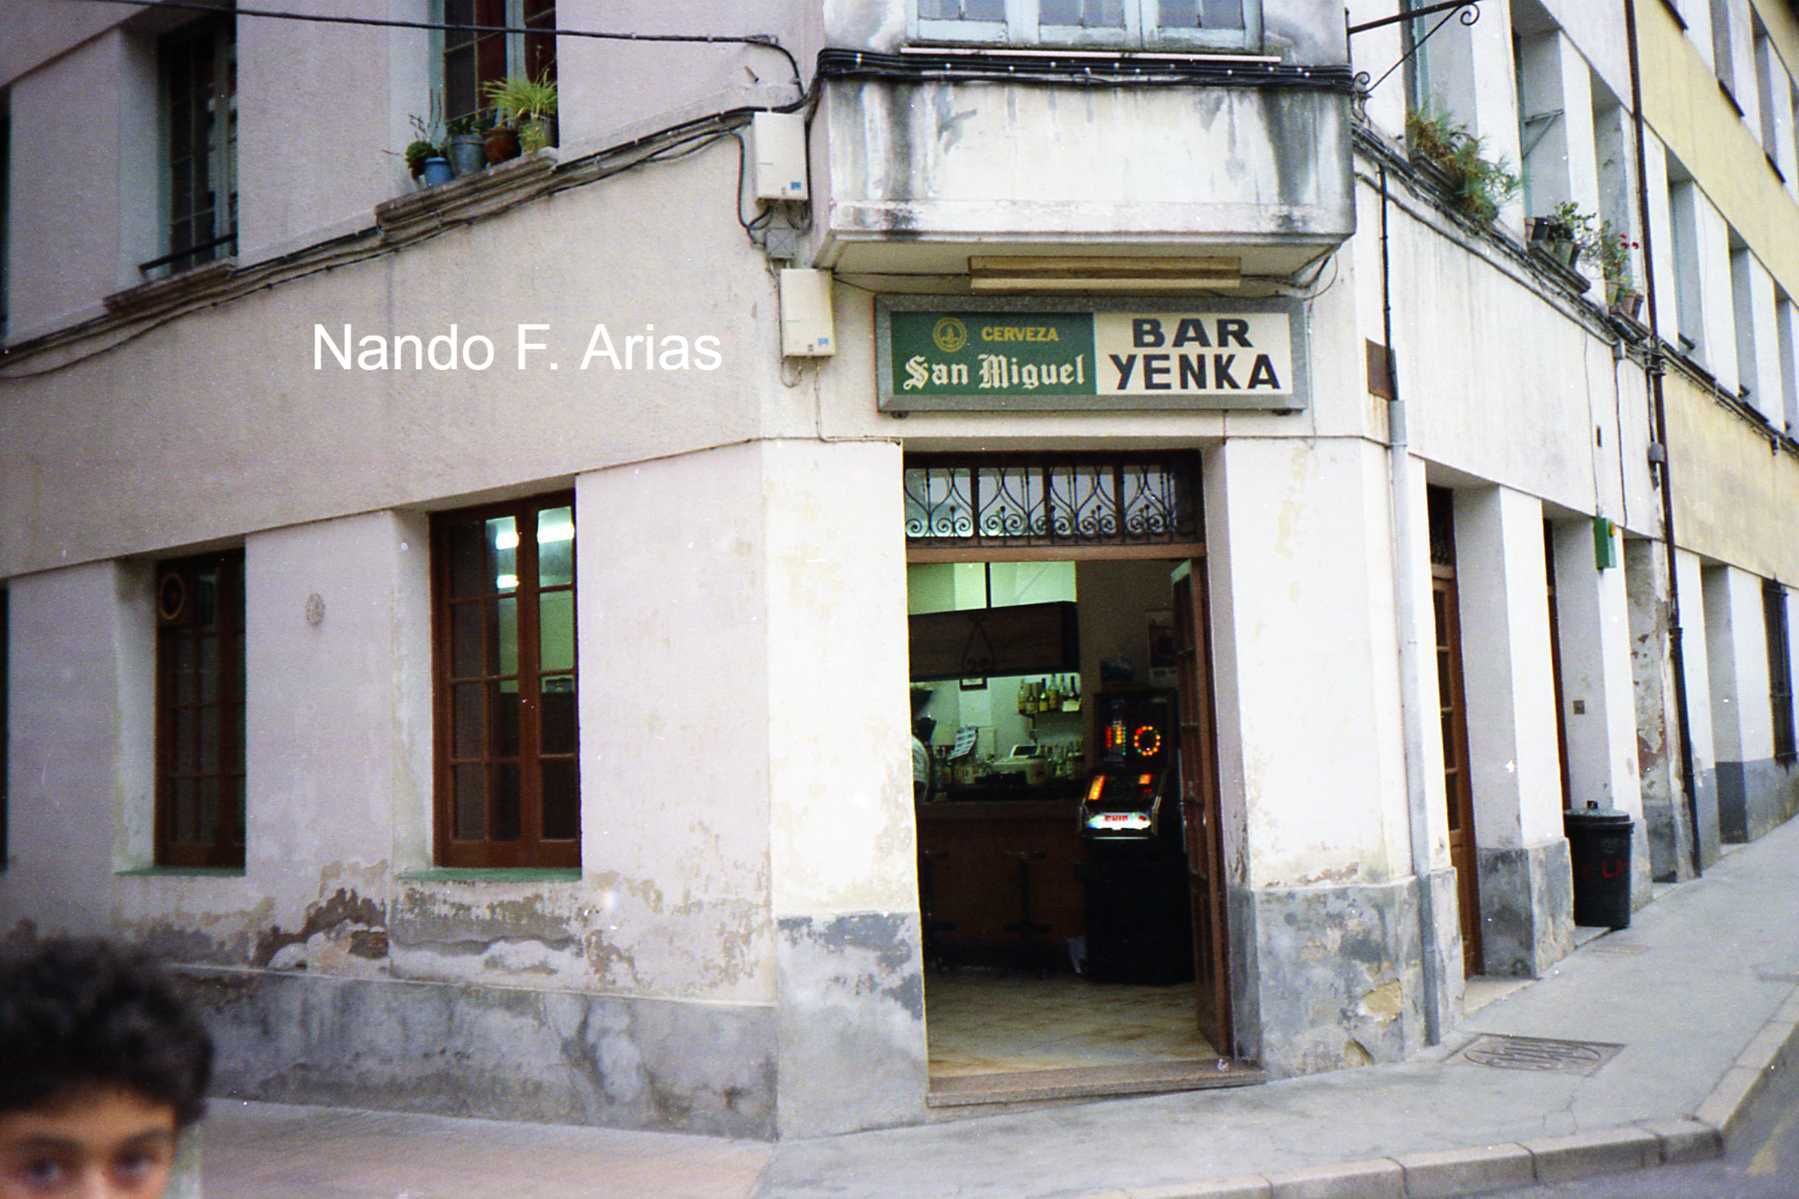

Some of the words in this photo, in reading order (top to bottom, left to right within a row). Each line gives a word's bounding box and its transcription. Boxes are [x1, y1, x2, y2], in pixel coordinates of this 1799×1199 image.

[981, 326, 1059, 342] CERVEZA
[1132, 318, 1254, 348] BAR
[903, 354, 969, 390] San
[978, 353, 1085, 390] Miguel
[1109, 353, 1281, 390] YENKA
